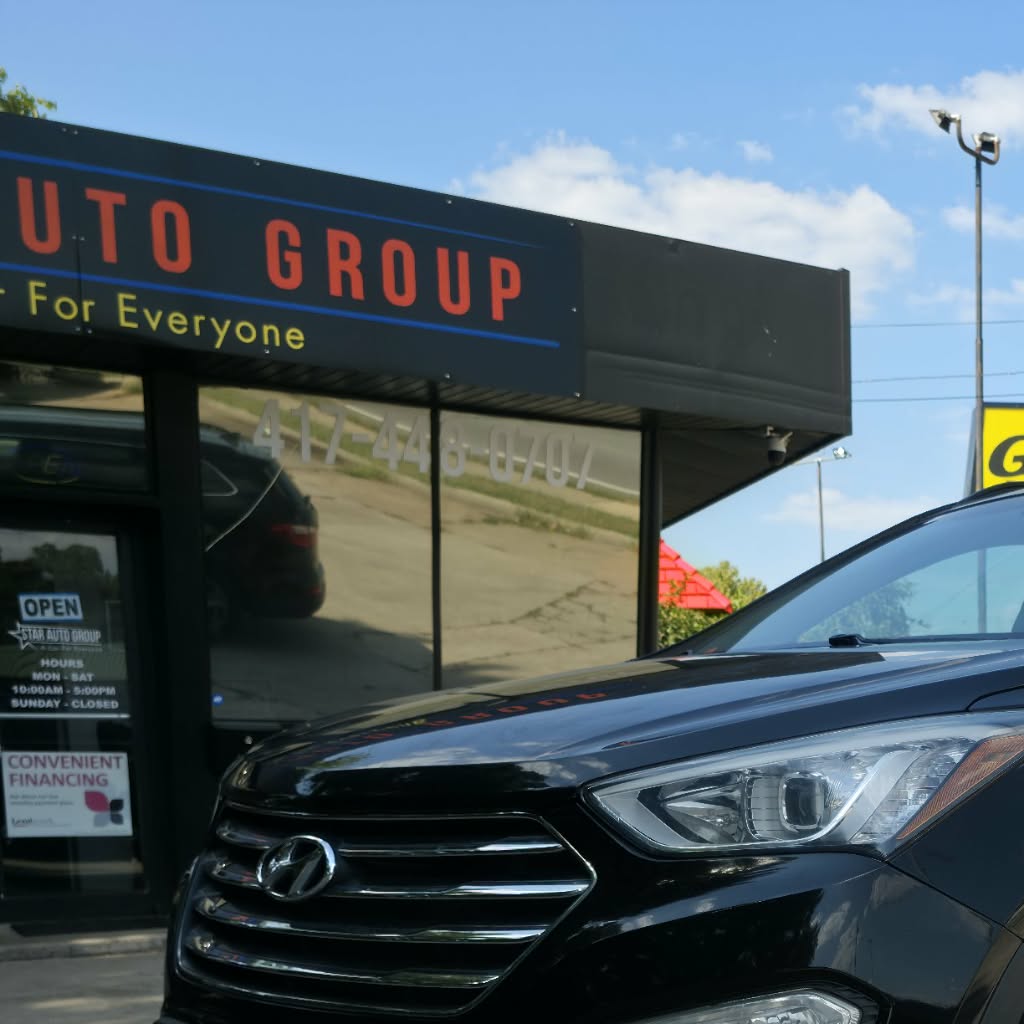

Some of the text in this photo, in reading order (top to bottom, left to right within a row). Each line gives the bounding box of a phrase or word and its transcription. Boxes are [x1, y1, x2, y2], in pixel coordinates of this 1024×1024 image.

[17, 177, 521, 321] UTO GROUP
[27, 280, 305, 350] For Everyone
[24, 598, 79, 617] OPEN
[22, 627, 102, 643] STAR AUTO GROUP
[40, 658, 85, 668] HOURS
[31, 672, 61, 682] MON
[71, 672, 95, 682] SAT
[10, 699, 62, 709] SUNDAY
[71, 699, 120, 709] CLOSED
[8, 754, 123, 770] CONVENIENT
[9, 773, 109, 788] FINANCING
